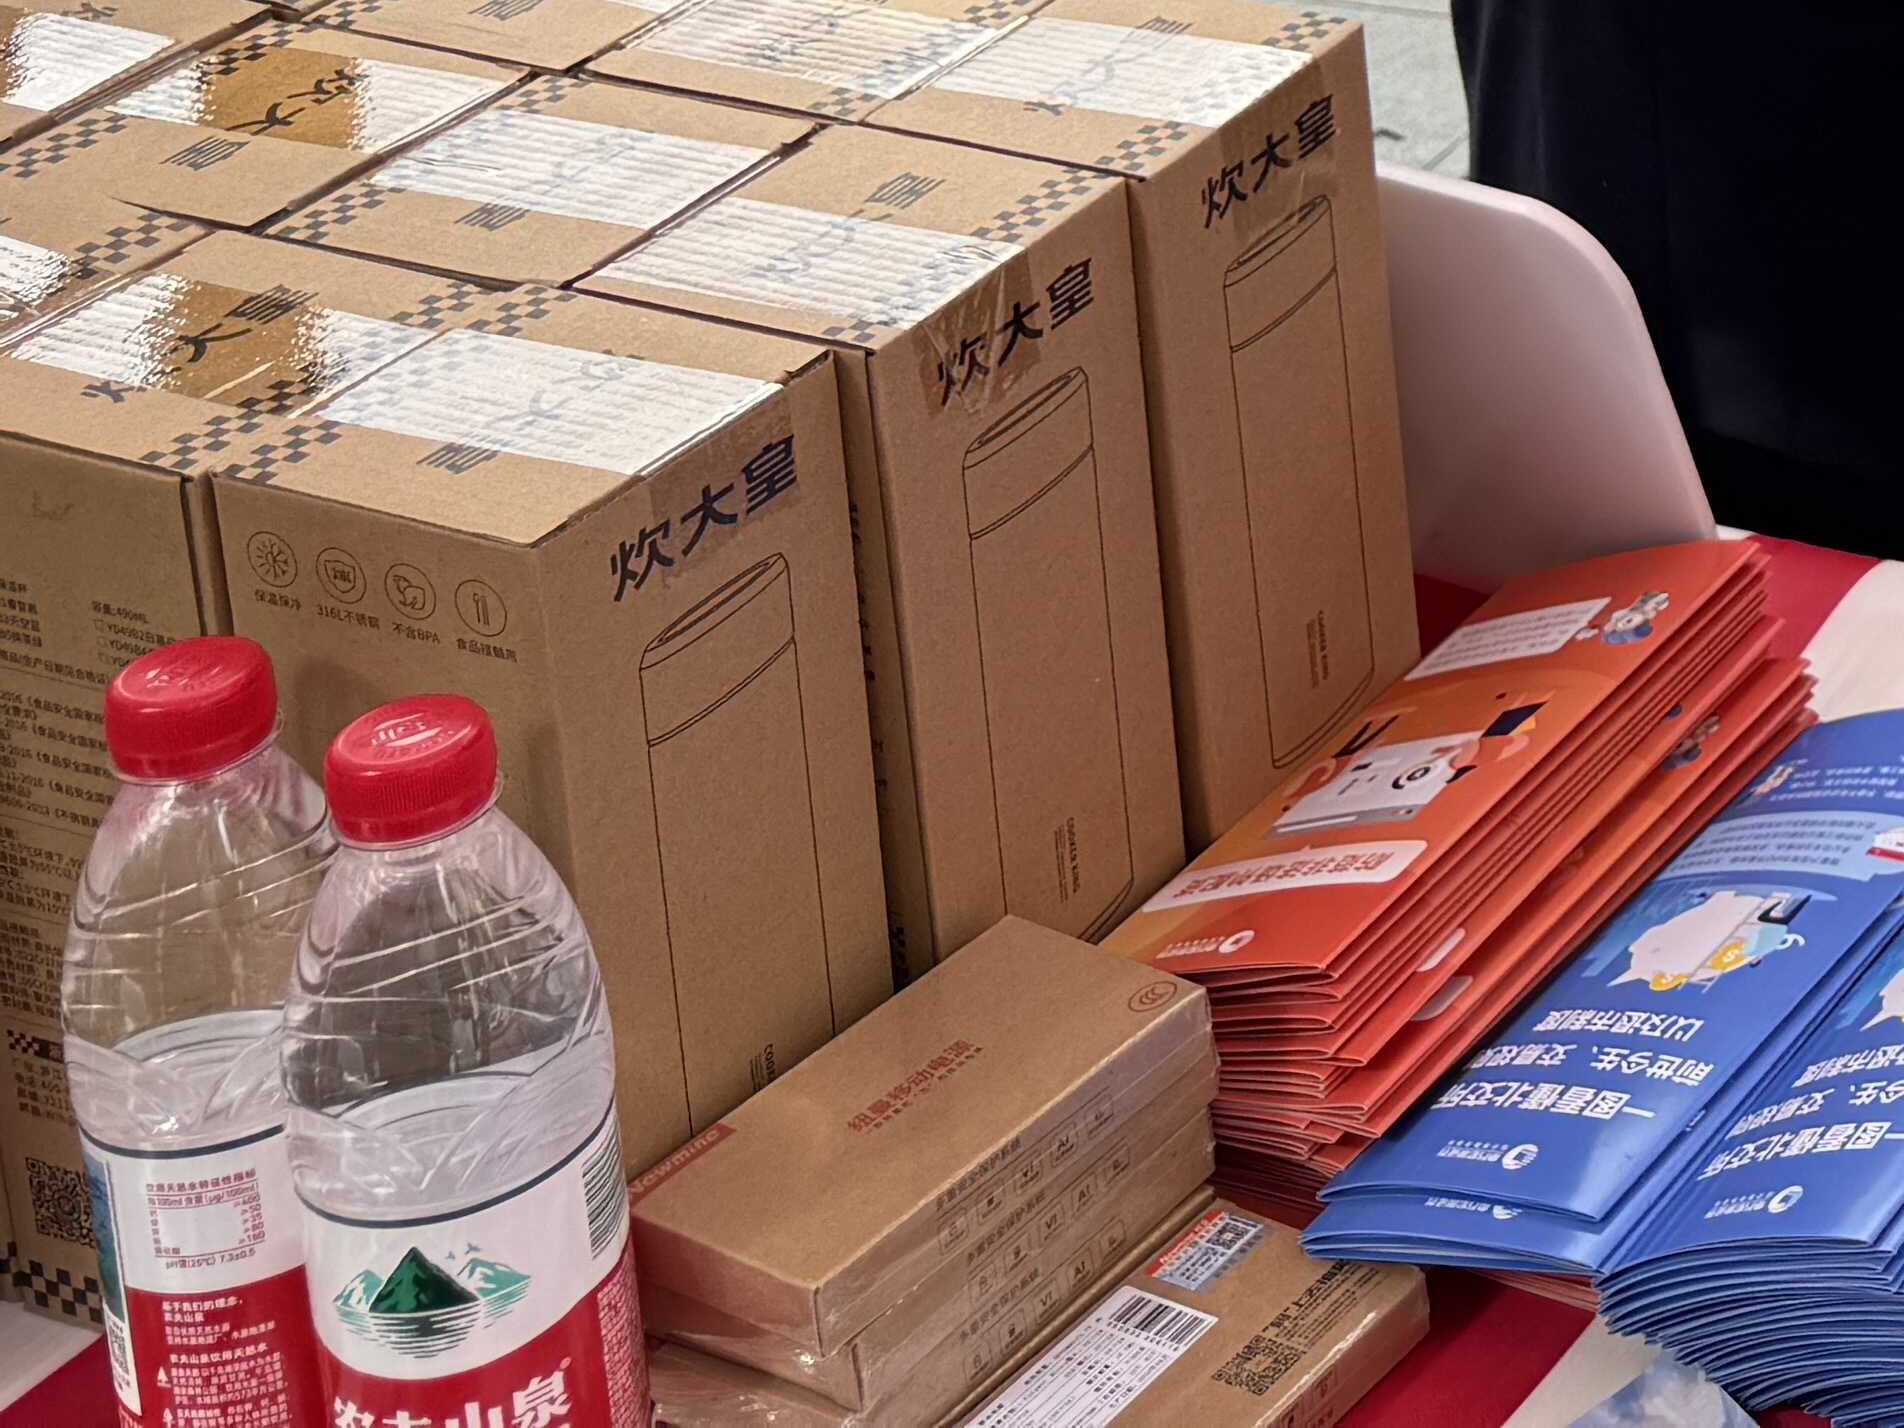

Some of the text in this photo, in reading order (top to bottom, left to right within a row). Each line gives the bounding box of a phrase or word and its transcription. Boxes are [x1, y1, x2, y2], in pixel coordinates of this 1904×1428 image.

[1201, 94, 1337, 228] 炊大皇
[938, 258, 1094, 407] 炊大皇
[609, 432, 799, 603] 炊大皇
[316, 603, 381, 630] 316L不锈钢
[392, 621, 441, 646] 不含BPA
[1532, 1008, 1705, 1042] 以及退市制度
[847, 1038, 975, 1135] 纽曼移动电源
[1429, 1080, 1657, 1121] 一图看懂北交所
